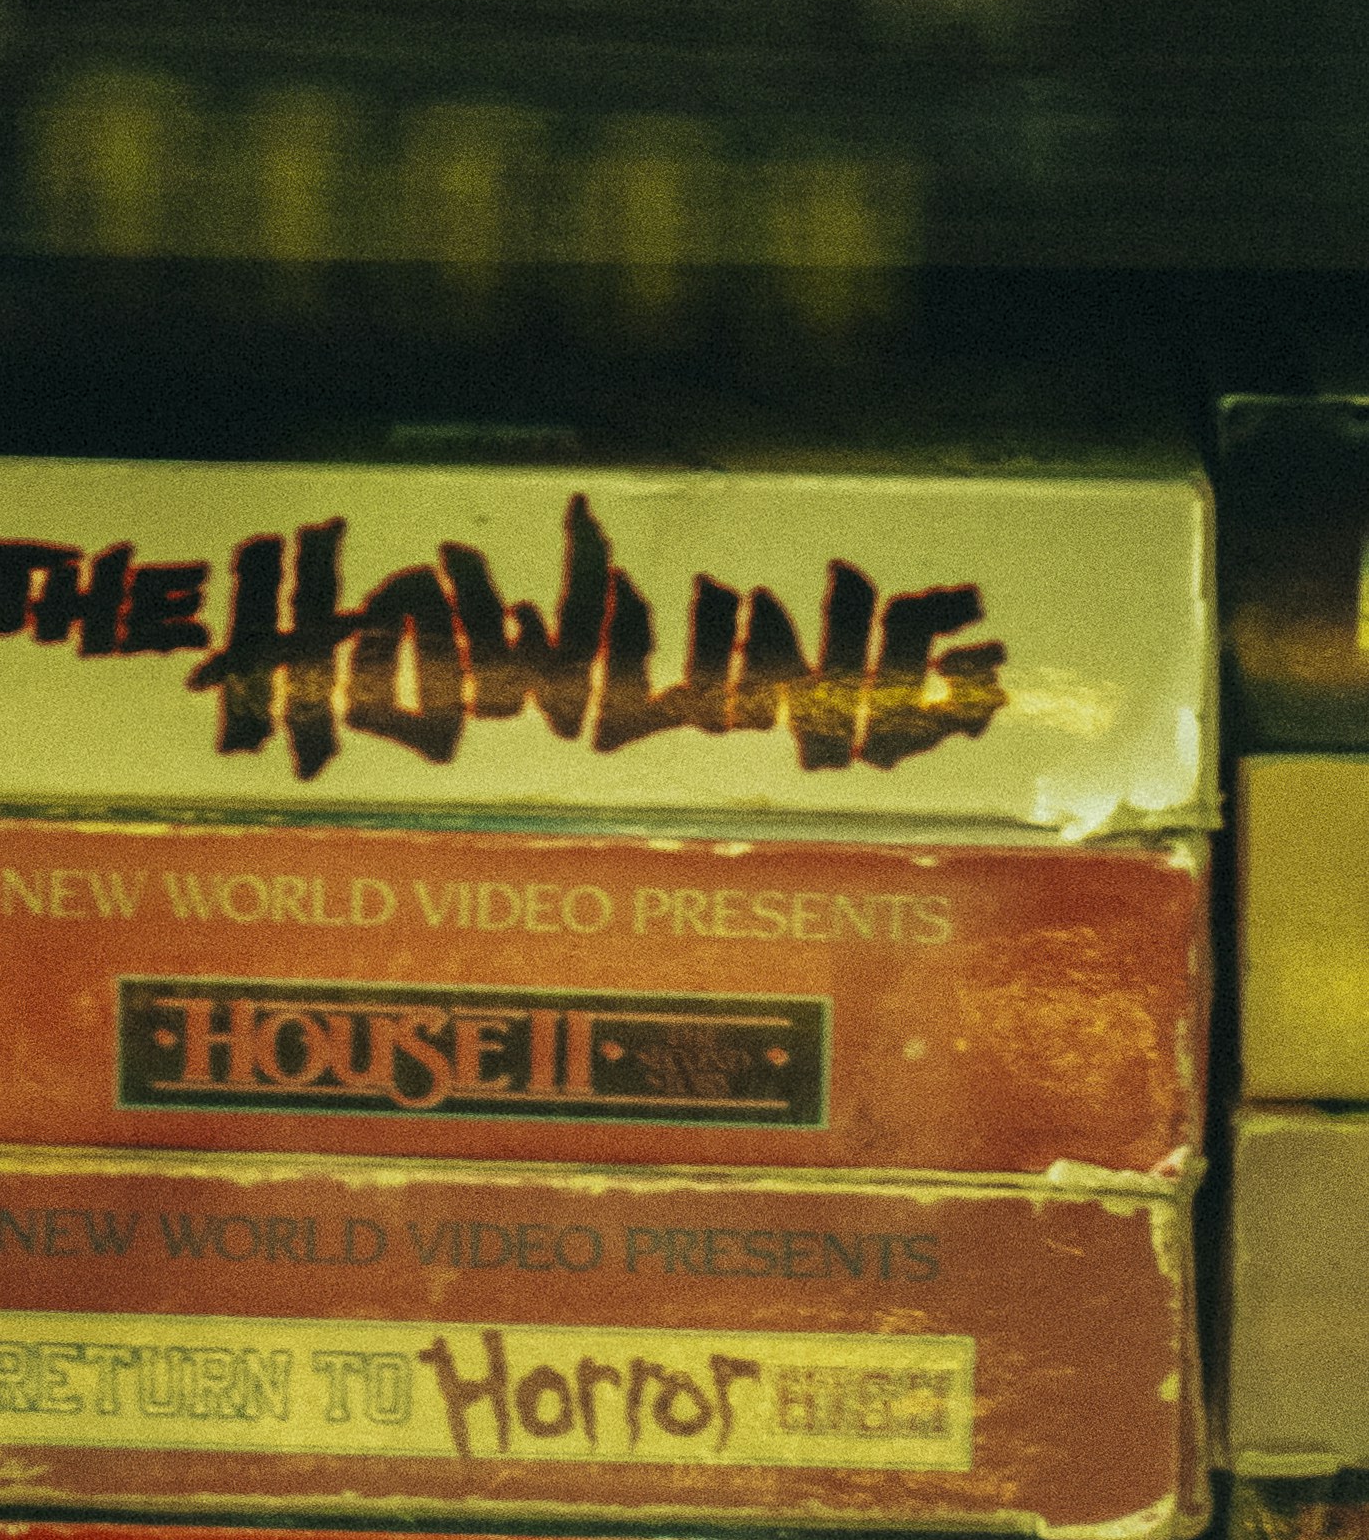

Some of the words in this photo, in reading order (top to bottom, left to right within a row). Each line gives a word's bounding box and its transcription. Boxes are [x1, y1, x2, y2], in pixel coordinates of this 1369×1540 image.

[185, 493, 1007, 783] HOWLING
[0, 867, 141, 921] NEW
[163, 871, 400, 931] WORLD
[412, 878, 617, 938] VIDEO
[631, 885, 957, 948] PRESENTS
[181, 998, 511, 1109] HOUSE
[526, 1008, 596, 1096] II
[159, 1209, 391, 1271] WORLD
[402, 1216, 607, 1278] VIDEO
[622, 1224, 945, 1288] PRESENTS
[311, 1348, 415, 1426] TO
[418, 1328, 761, 1457] Horror
